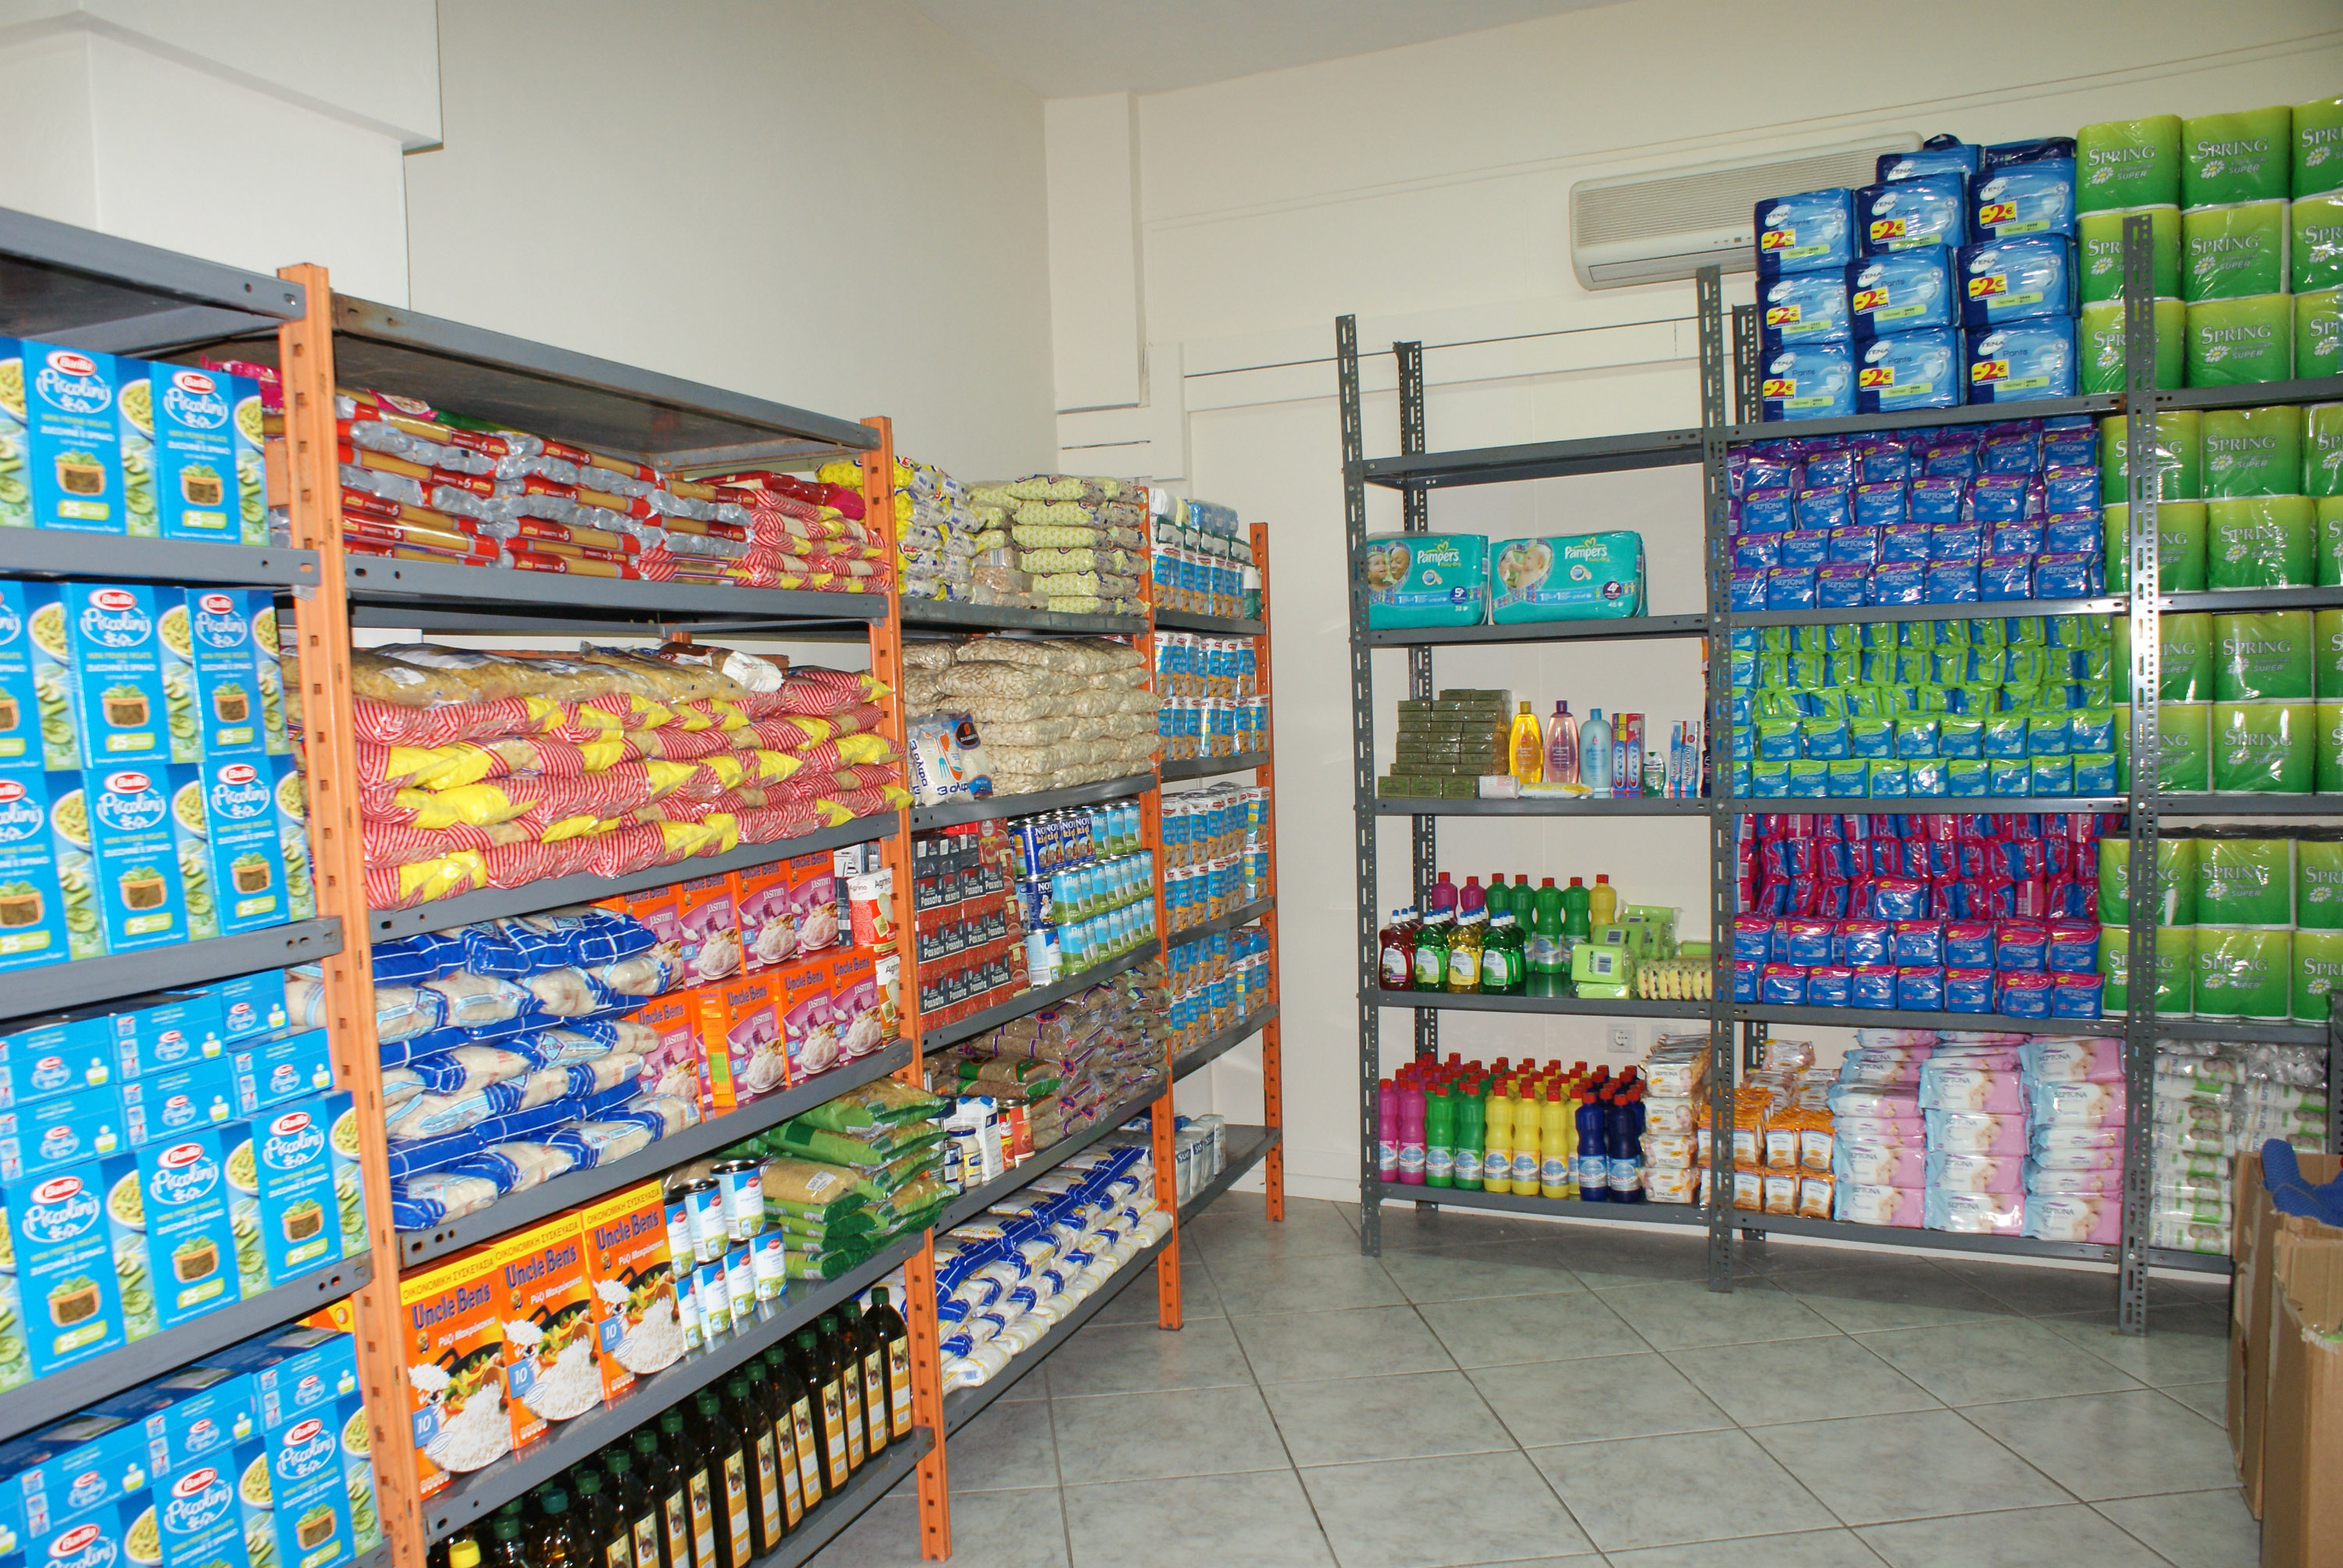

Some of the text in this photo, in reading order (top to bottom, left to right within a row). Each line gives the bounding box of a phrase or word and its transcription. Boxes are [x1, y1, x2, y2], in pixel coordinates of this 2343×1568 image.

[2302, 127, 2343, 147] SPRI
[2088, 145, 2156, 166] SPRING
[2197, 138, 2268, 159] SPRING
[2117, 171, 2146, 180] SUPER
[2229, 165, 2259, 174] SUPER
[1983, 184, 2005, 194] TENA
[1874, 198, 1895, 208] TENA
[1767, 212, 1789, 221] TENA
[1788, 219, 1810, 227] Pants
[2191, 235, 2259, 256] SPRING
[1970, 257, 1995, 266] TENA
[2220, 261, 2250, 269] SUPER
[1858, 271, 1881, 281] TENA
[1881, 278, 1905, 287] Pants
[2202, 325, 2271, 344] SPRING
[1865, 347, 1889, 357] TENA
[1981, 340, 2006, 348] TENA
[1888, 355, 1911, 364] Pants
[2002, 348, 2028, 357] Pants
[2232, 350, 2263, 358] SUPER
[58, 356, 93, 373] Barilla
[1771, 359, 1793, 368] TENA
[1792, 369, 1815, 377] Pants
[40, 369, 108, 397] Piccolini
[182, 376, 213, 392] Barilla
[167, 388, 225, 415] Piccolini
[2206, 435, 2275, 451] SPRING
[2237, 460, 2267, 469] SUPER
[2220, 525, 2288, 542] SPRING
[1417, 550, 1460, 566] Pampers
[1564, 546, 1608, 560] Pampers
[84, 609, 148, 633] Piccolini
[2224, 639, 2291, 655] SPRING
[2224, 729, 2292, 747] SPRING
[1614, 743, 1624, 787] Crest
[1628, 743, 1639, 787] Crest
[1682, 746, 1691, 783] Aquafresh
[116, 776, 148, 789] Barilla
[227, 768, 255, 781] Barilla
[213, 785, 268, 807] Piccolini
[937, 782, 968, 796] 3 αλφ
[99, 793, 162, 818] Piccolini
[2306, 866, 2343, 883] SPRI
[965, 884, 982, 895] Passata
[921, 894, 941, 907] Passata
[744, 932, 751, 940] 10
[988, 925, 1004, 936] Passata
[685, 946, 692, 955] 10
[925, 945, 943, 957] Passata
[946, 939, 963, 951] Passata
[833, 960, 853, 975] Uncle
[2304, 957, 2343, 975] SPRI
[785, 975, 806, 991] Uncle
[992, 972, 1008, 983] Passata
[727, 989, 749, 1007] Uncle
[925, 996, 943, 1009] Passata
[950, 989, 966, 1000] Passata
[638, 1009, 663, 1025] Uncle
[278, 1114, 310, 1131] Barilla
[266, 1129, 321, 1162] Piccolini
[168, 1145, 201, 1164] Barilla
[1178, 1151, 1190, 1161] SUG
[154, 1162, 216, 1195] Piccolini
[42, 1178, 80, 1200] Barilla
[626, 1188, 659, 1208] ΣΥΣΚΕΥΑΣΙΑ
[25, 1195, 97, 1232] Piccolini
[541, 1221, 578, 1243] ΣΥΣΚΕΥΑΣΙΑ
[595, 1210, 659, 1250] Uncle Ben's
[453, 1258, 494, 1281] ΣΥΣΚΕΥΑΣΙΑ
[505, 1245, 577, 1288] Uncle Ben's
[412, 1283, 490, 1329] Uncle Ben's
[605, 1324, 617, 1338] 10
[513, 1367, 528, 1384] 10
[291, 1420, 321, 1441] Barilla
[417, 1415, 432, 1432] 10
[280, 1437, 333, 1472] Piccolini
[183, 1470, 215, 1493] Barilla
[167, 1484, 229, 1522] Piccolini
[59, 1525, 98, 1552] Barilla
